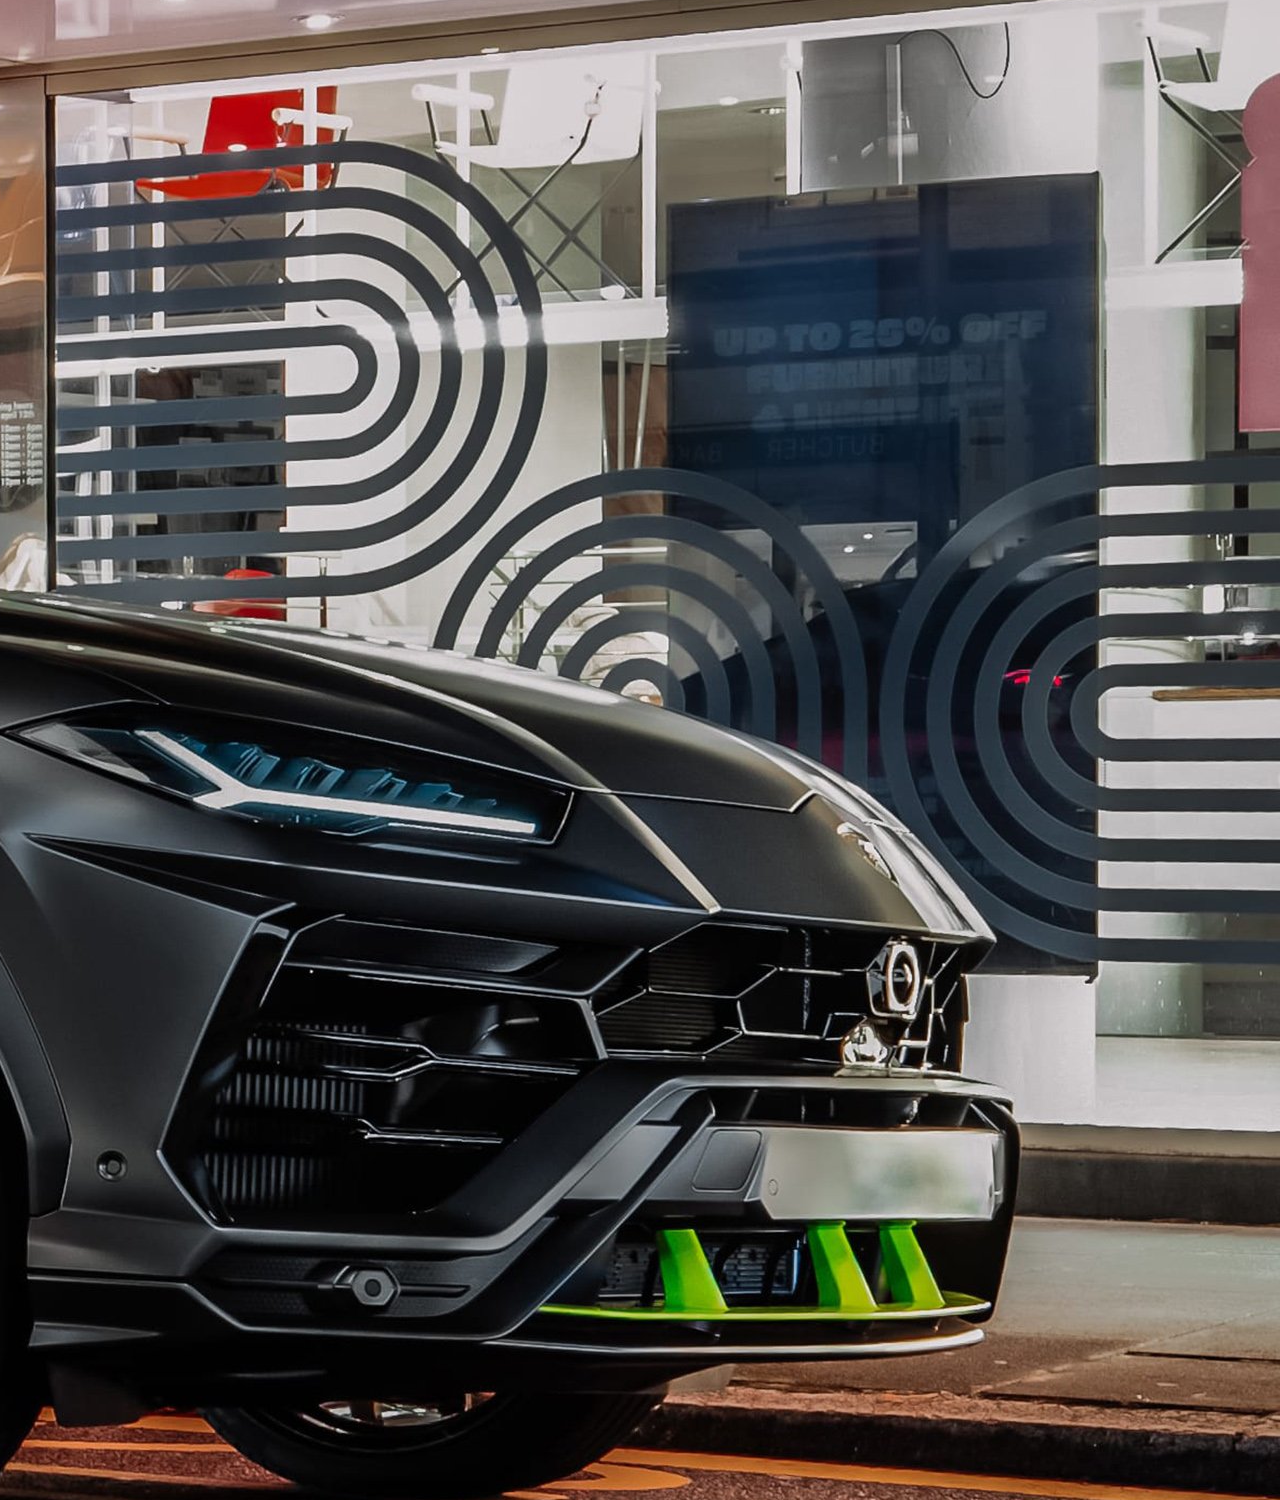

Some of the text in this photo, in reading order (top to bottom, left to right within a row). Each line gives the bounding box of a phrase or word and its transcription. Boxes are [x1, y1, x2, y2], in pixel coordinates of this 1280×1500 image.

[714, 310, 1048, 358] UP TO 25% OFF
